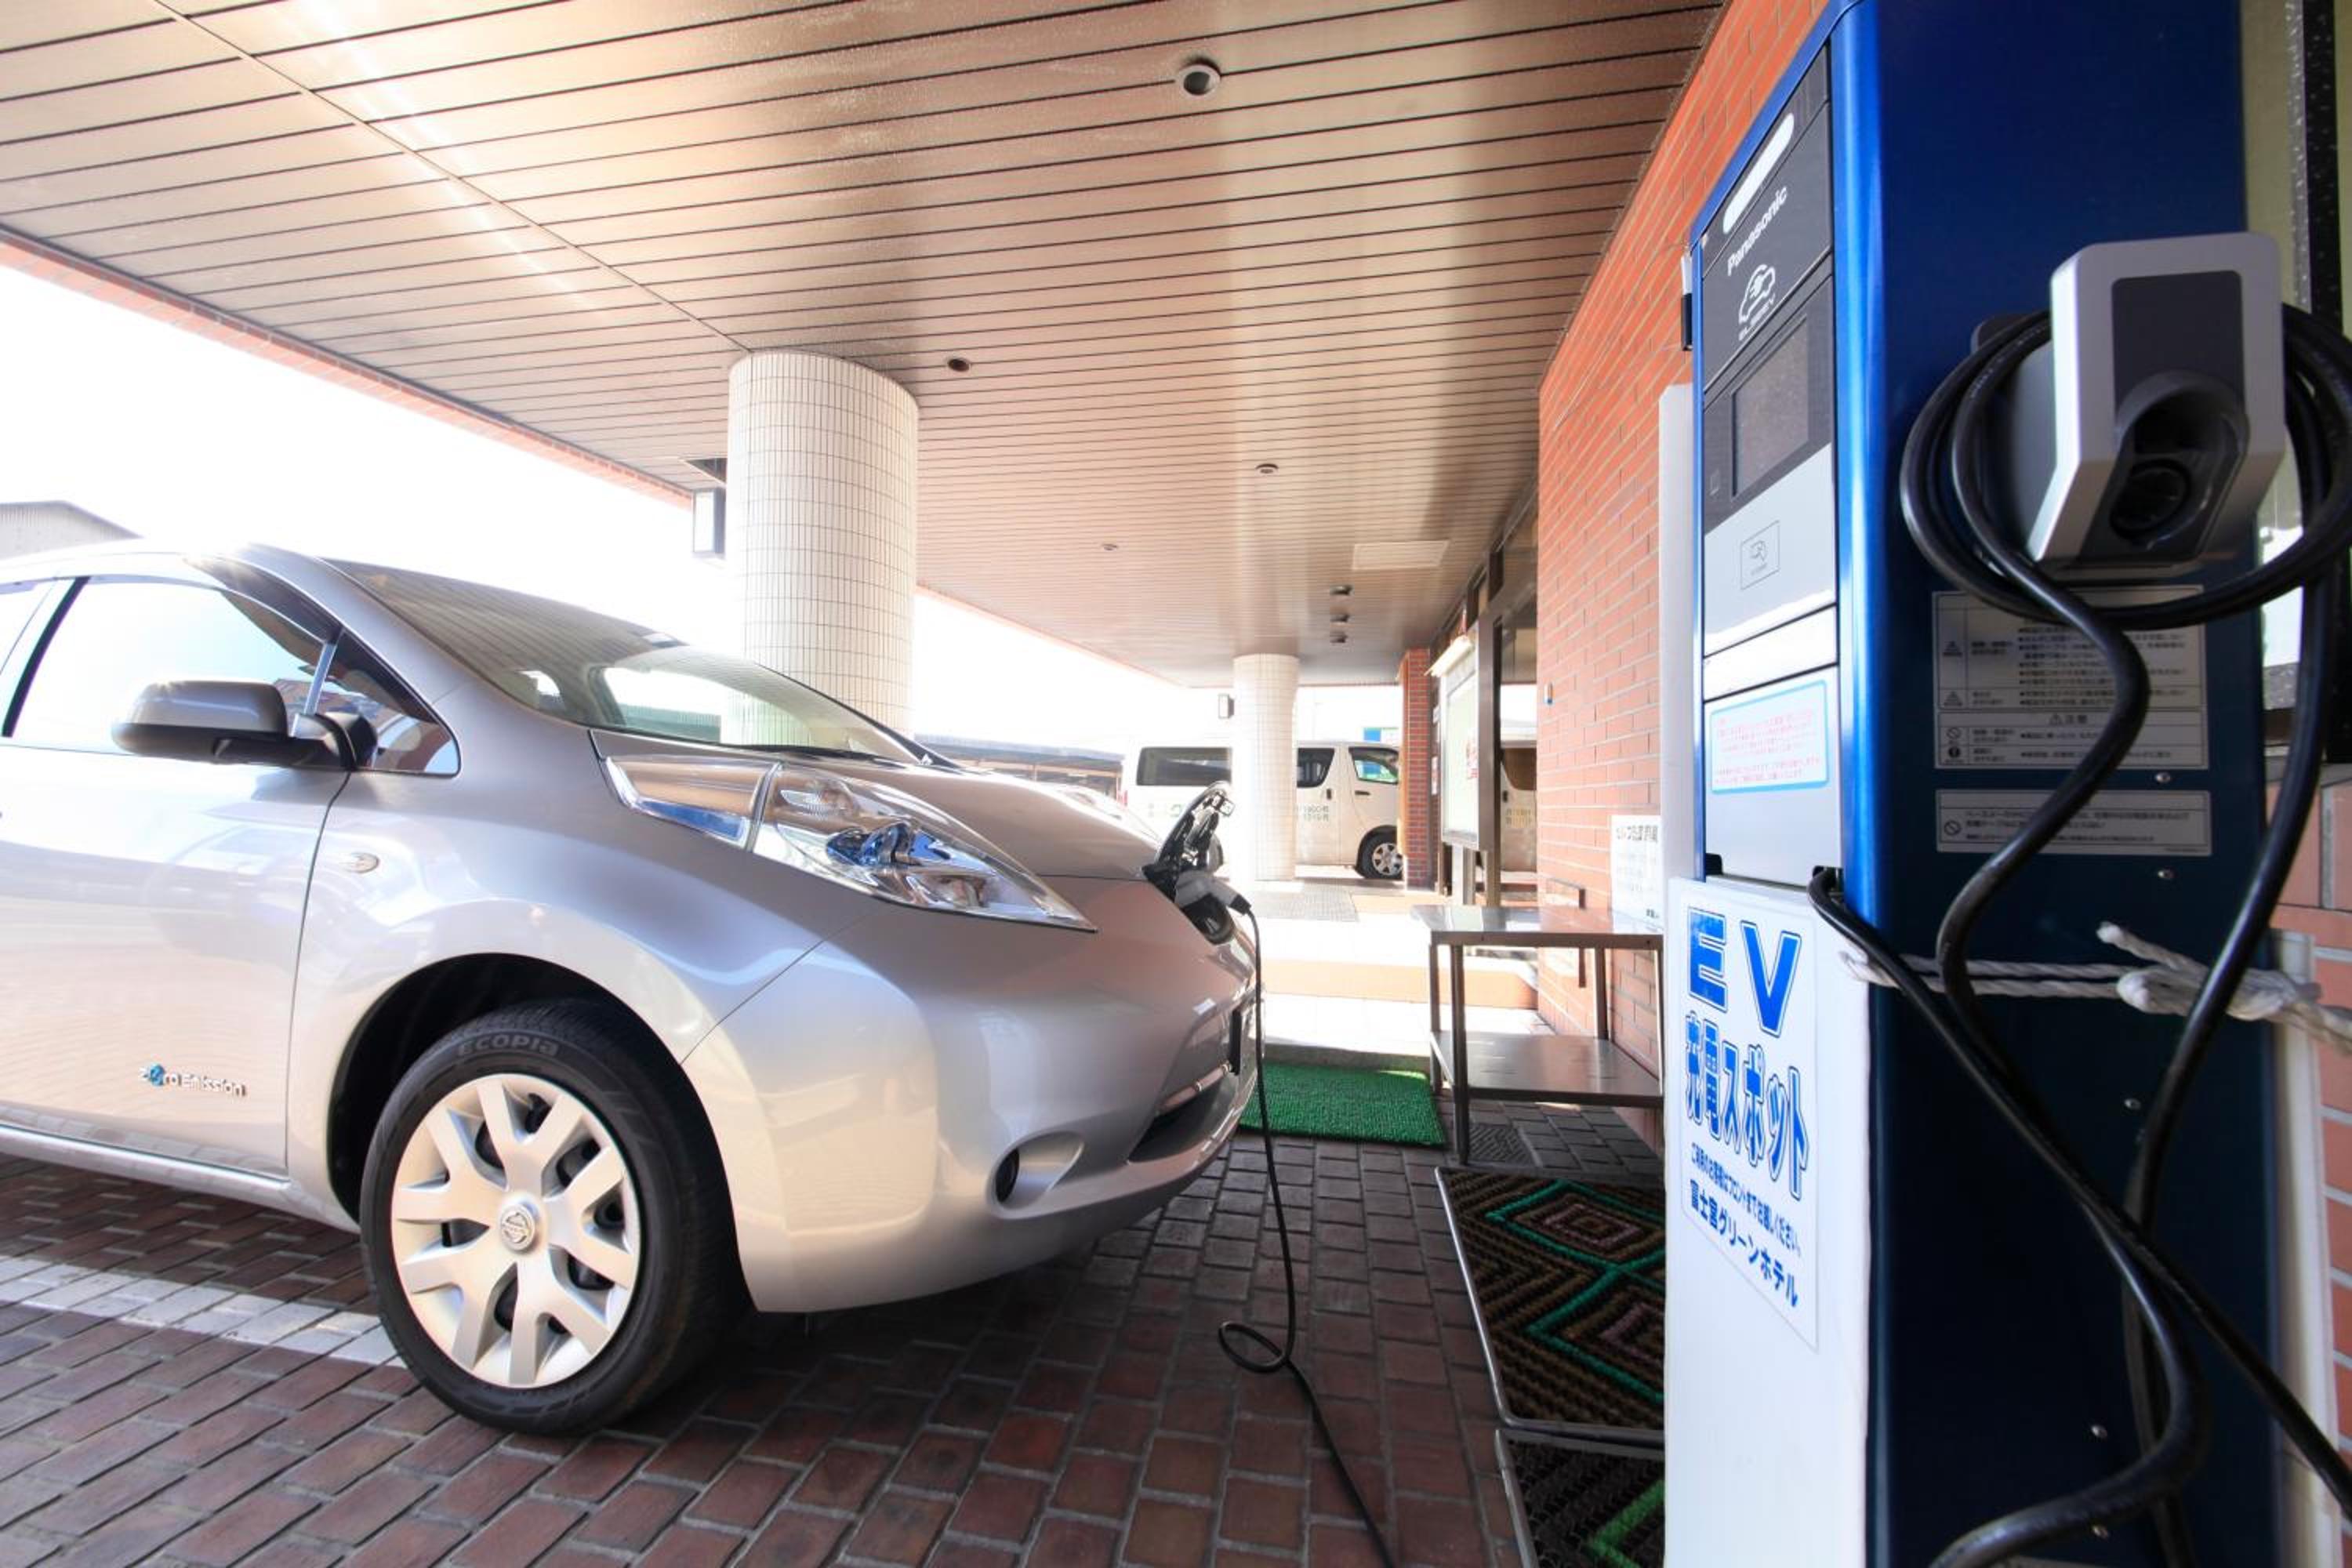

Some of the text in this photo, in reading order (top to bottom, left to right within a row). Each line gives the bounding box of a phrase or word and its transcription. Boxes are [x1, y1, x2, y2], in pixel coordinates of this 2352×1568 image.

[1727, 186, 1788, 276] Panasonic
[1688, 906, 1802, 1038] EV
[1686, 1010, 1809, 1200] 充電スポット
[1690, 1178, 1798, 1308] 富士宮グリーンホテル
